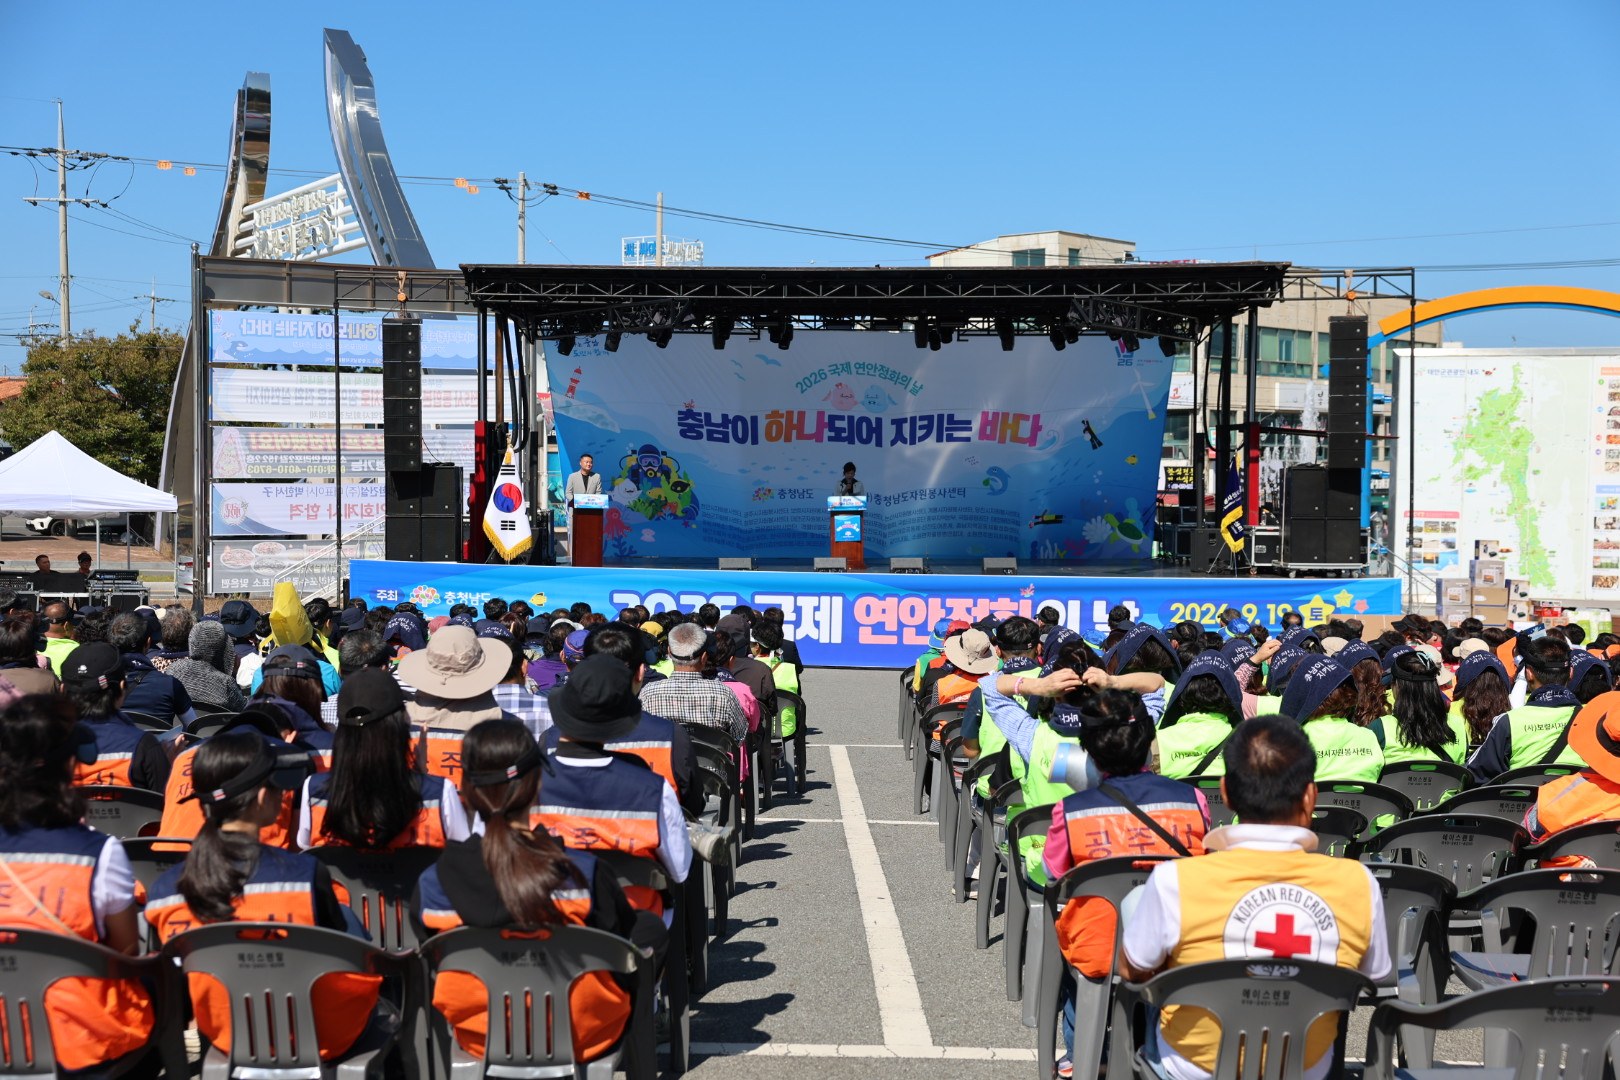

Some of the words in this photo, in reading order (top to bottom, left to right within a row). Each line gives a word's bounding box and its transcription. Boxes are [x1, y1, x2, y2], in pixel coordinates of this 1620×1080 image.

[796, 368, 828, 394] 2026
[828, 362, 852, 376] 국제
[854, 362, 912, 390] 연안정화의
[909, 380, 924, 396] 날
[678, 410, 759, 446] 충남이
[764, 410, 883, 446] 하나되어
[890, 414, 973, 446] 지키는
[978, 410, 1043, 446] 바다
[778, 488, 814, 500] 충청남도
[376, 590, 398, 602] 주최
[444, 591, 492, 606] 충청남도
[1309, 608, 1323, 621] 토
[1304, 660, 1324, 682] 충남이
[1316, 664, 1337, 680] 지키는
[1442, 834, 1474, 842] 에이스렌탈
[1558, 891, 1598, 900] 에이스렌탈
[1234, 883, 1276, 924] KOREAN
[1280, 882, 1302, 903] RED
[1302, 893, 1334, 932] CROSS
[238, 952, 284, 962] 에이스렌탈
[1242, 988, 1290, 1000] 에이스렌탈
